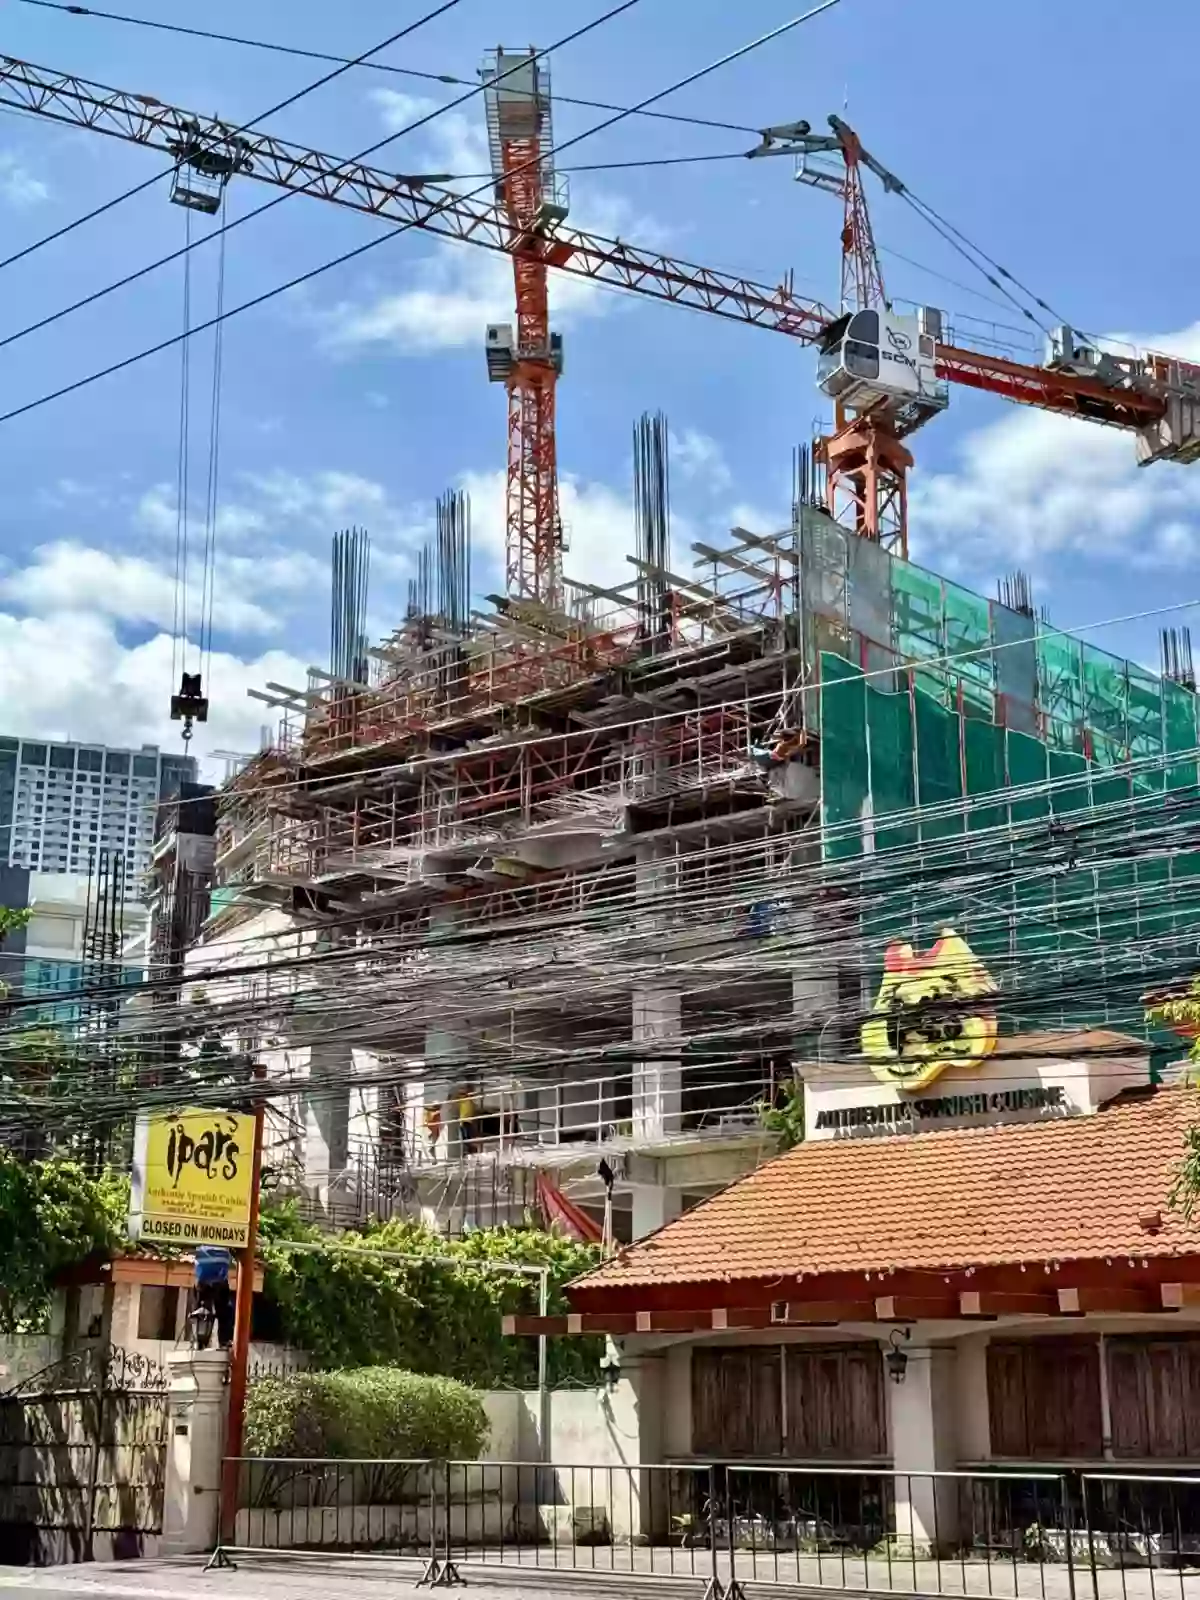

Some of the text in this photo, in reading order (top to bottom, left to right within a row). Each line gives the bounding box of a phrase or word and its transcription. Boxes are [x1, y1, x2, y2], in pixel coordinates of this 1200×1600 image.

[881, 351, 916, 367] SCM
[143, 1219, 245, 1242] CLOSED ON MONDAYS
